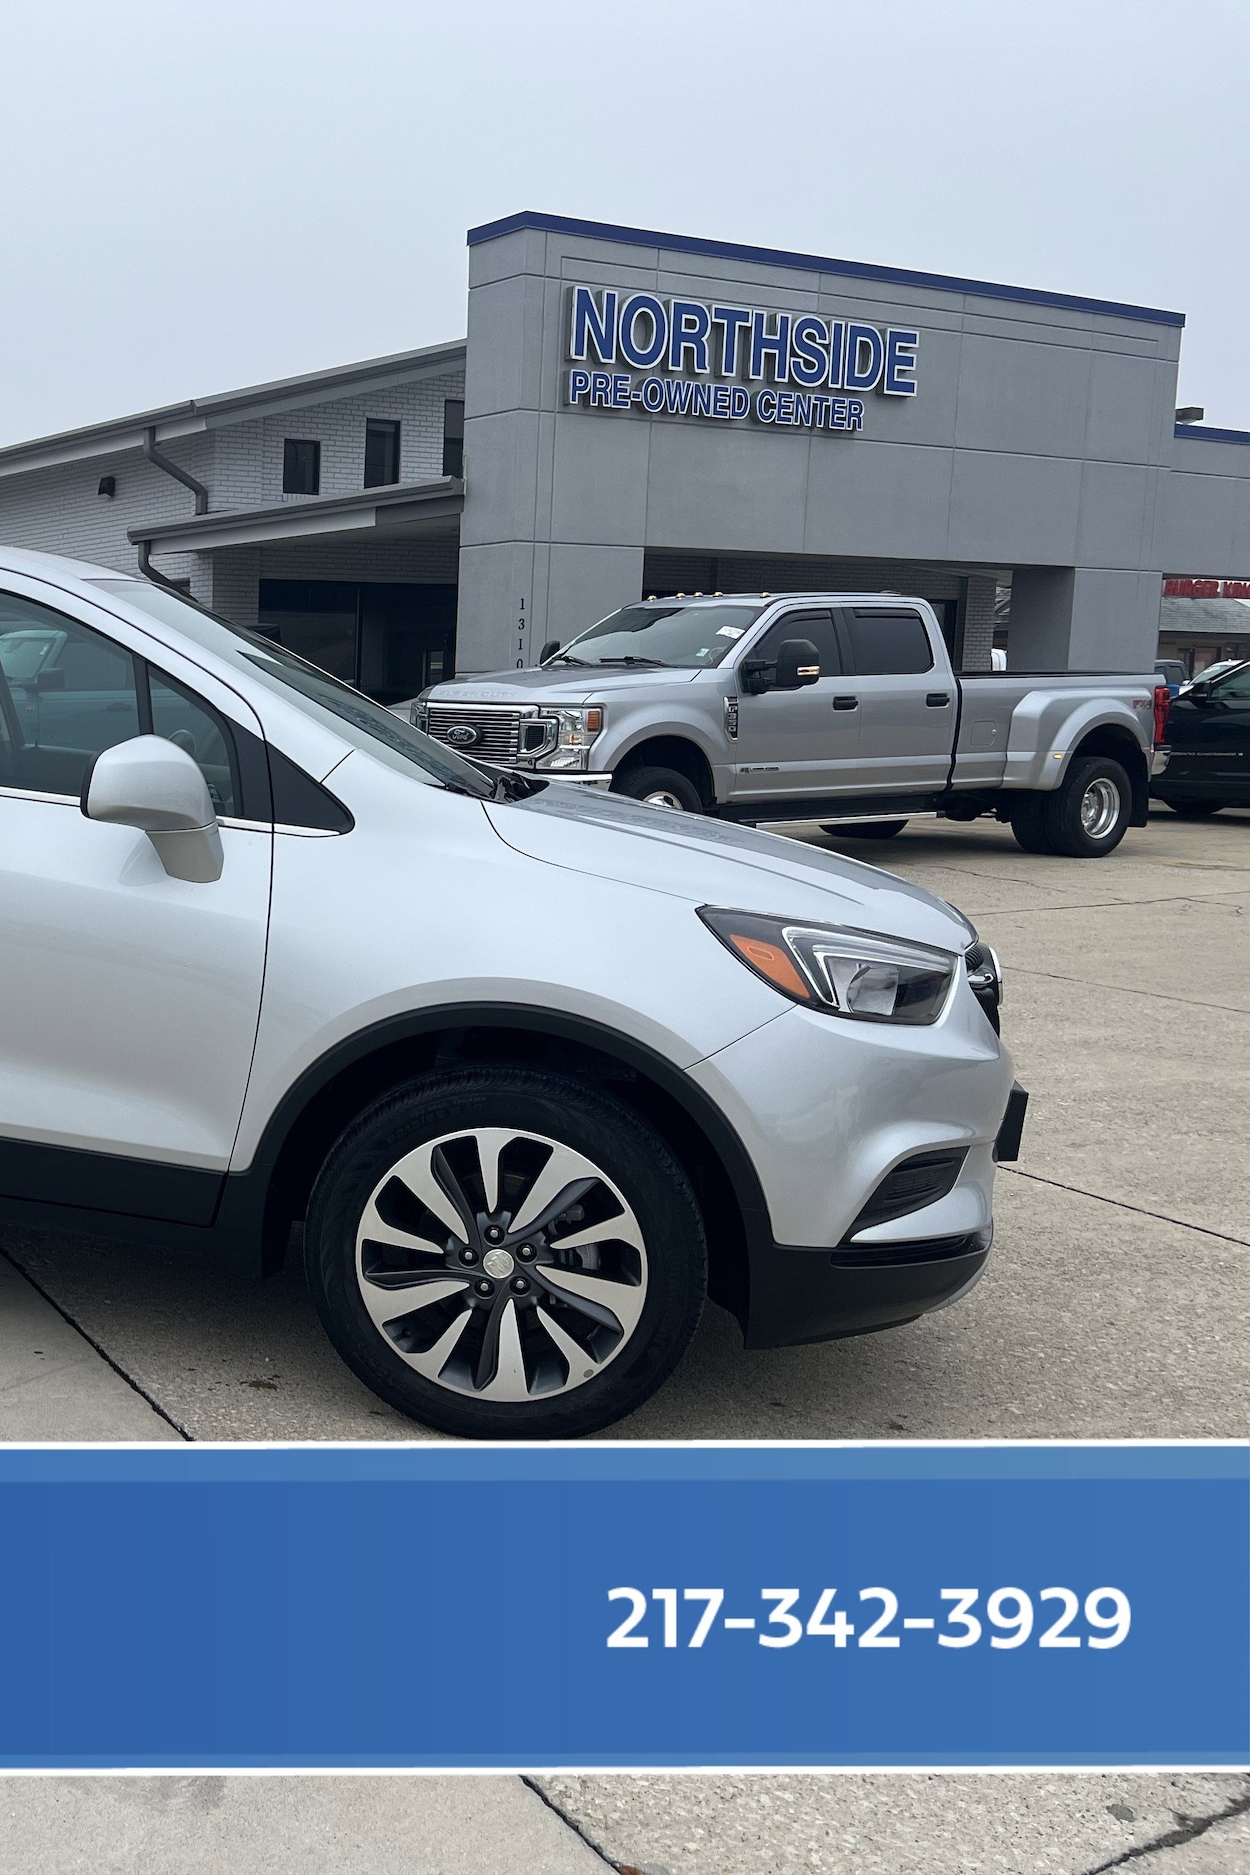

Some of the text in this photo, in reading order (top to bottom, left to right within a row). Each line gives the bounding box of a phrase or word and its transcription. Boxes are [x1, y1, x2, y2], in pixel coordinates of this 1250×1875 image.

[571, 286, 920, 397] NORTHSIDE
[569, 369, 864, 431] PRE-OWNED CENTER
[1163, 579, 1219, 598] BURGER
